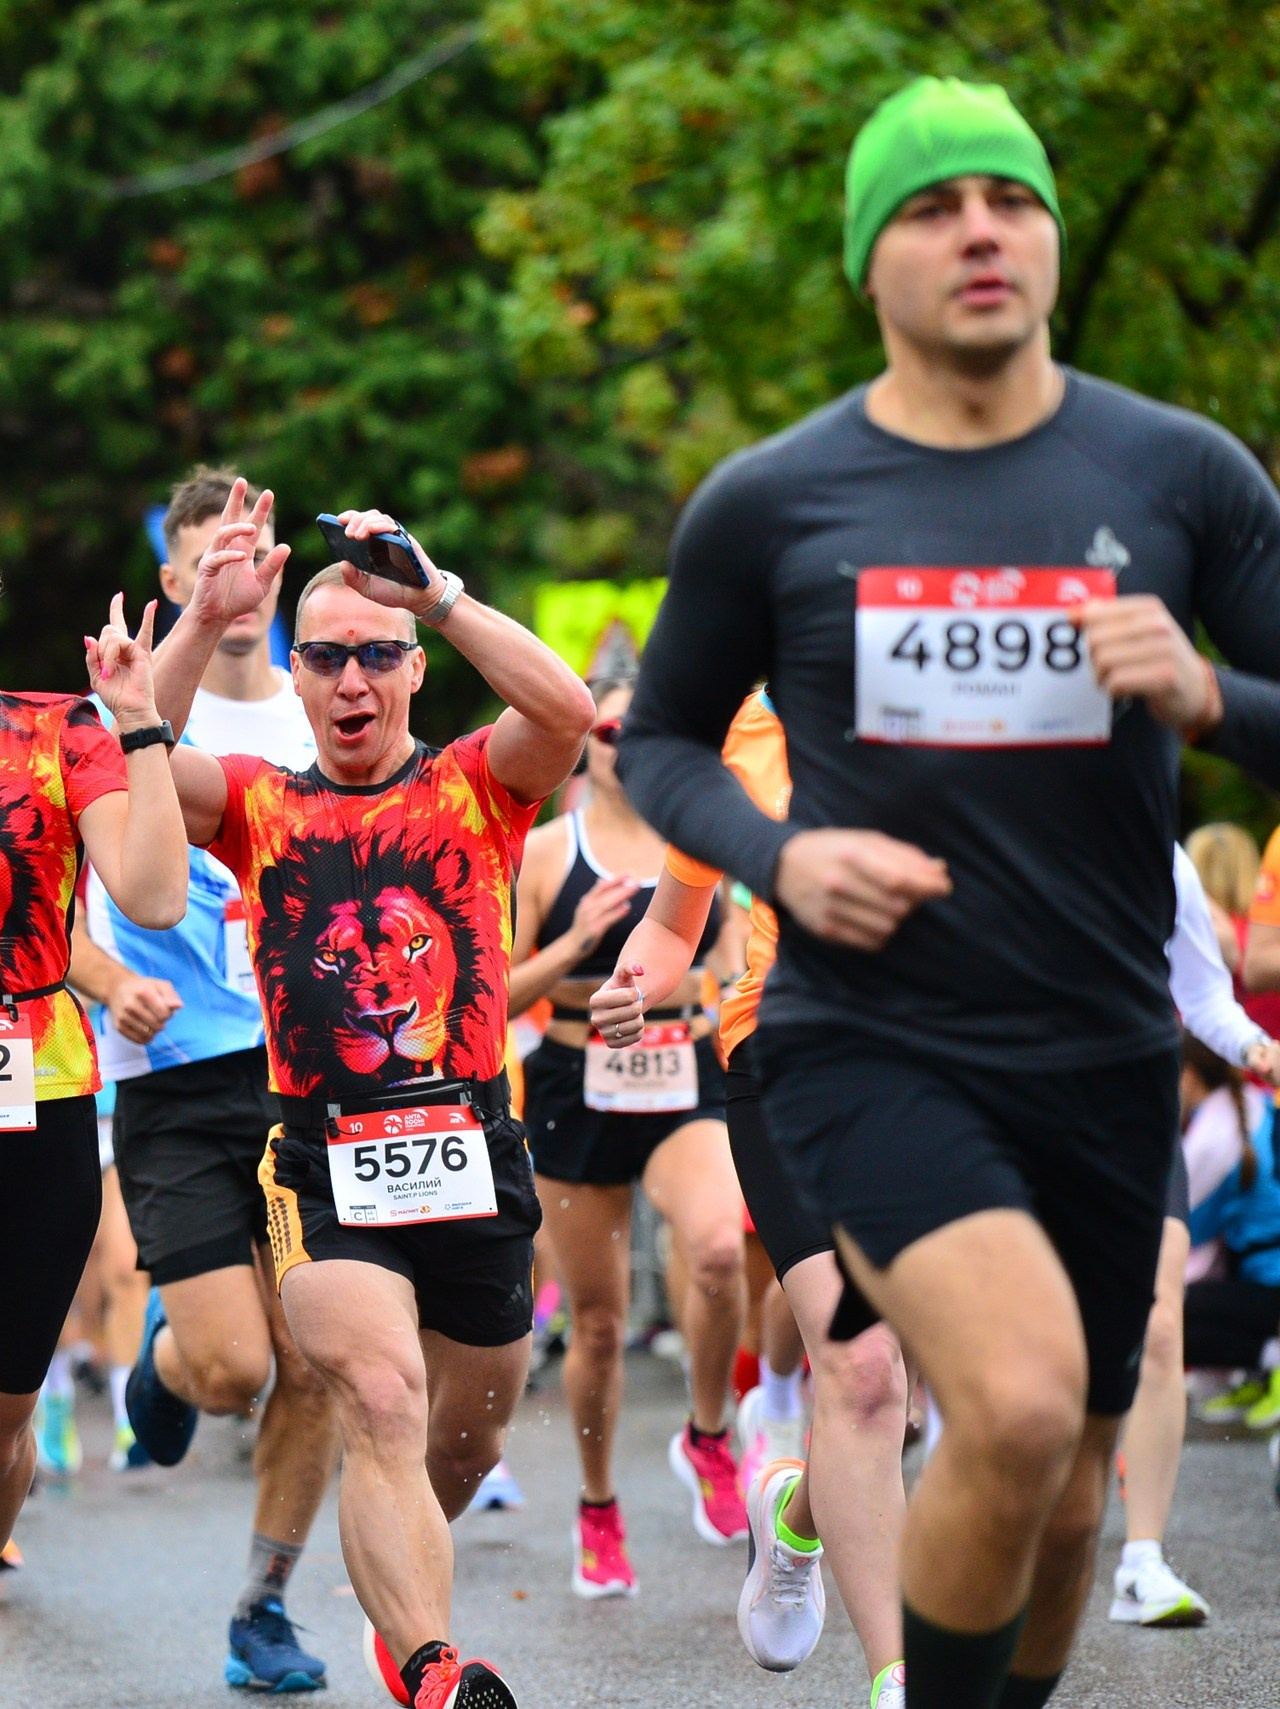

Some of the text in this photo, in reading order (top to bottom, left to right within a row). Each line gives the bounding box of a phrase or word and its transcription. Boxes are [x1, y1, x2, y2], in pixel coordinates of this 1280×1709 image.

[890, 619, 1081, 672] 4898
[605, 1051, 680, 1077] 4813
[349, 1122, 363, 1133] 10
[354, 1136, 467, 1182] 5576
[387, 1177, 442, 1193] ВАСИЛИЙ
[418, 1190, 438, 1198] LIONS
